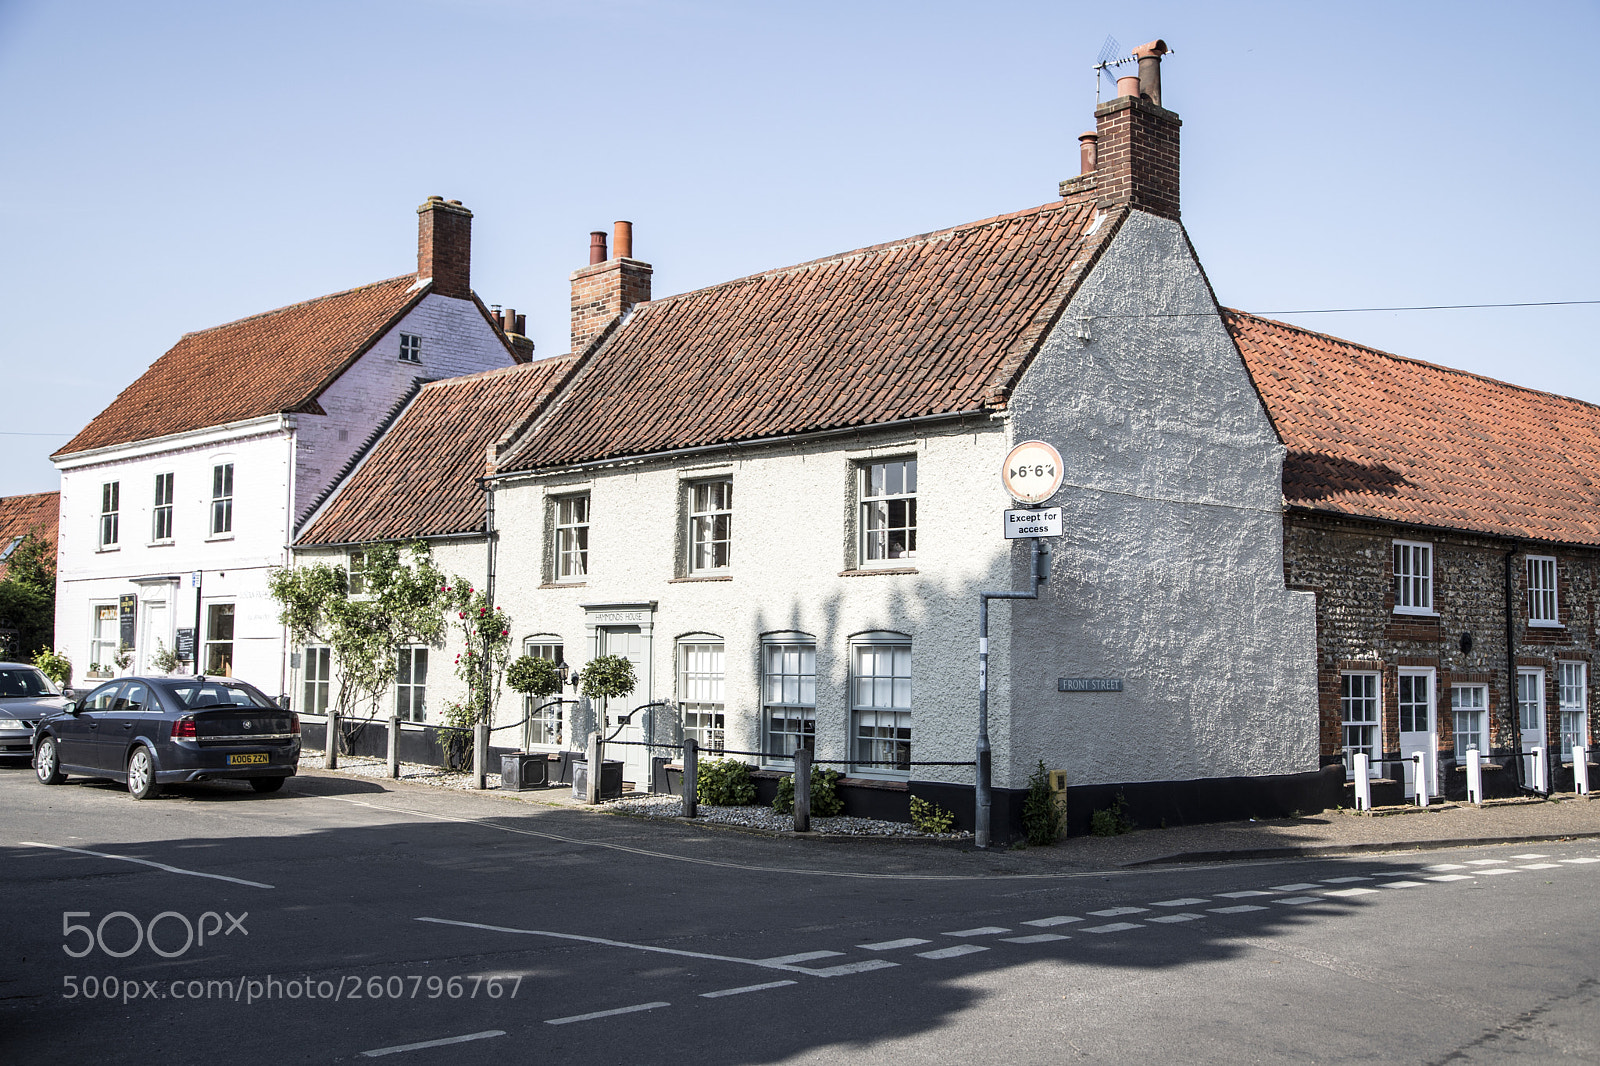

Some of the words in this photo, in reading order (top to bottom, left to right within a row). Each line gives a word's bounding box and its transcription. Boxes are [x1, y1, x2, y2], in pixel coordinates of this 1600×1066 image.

[1009, 514, 1040, 523] Except
[1044, 513, 1058, 521] for
[1018, 525, 1049, 534] access
[595, 613, 623, 621] HAMMONDS
[626, 613, 642, 621] HOUSE
[1063, 679, 1088, 690] FRONT
[1091, 679, 1120, 690] STREET
[231, 755, 252, 763] AO06
[253, 754, 268, 763] ZZN
